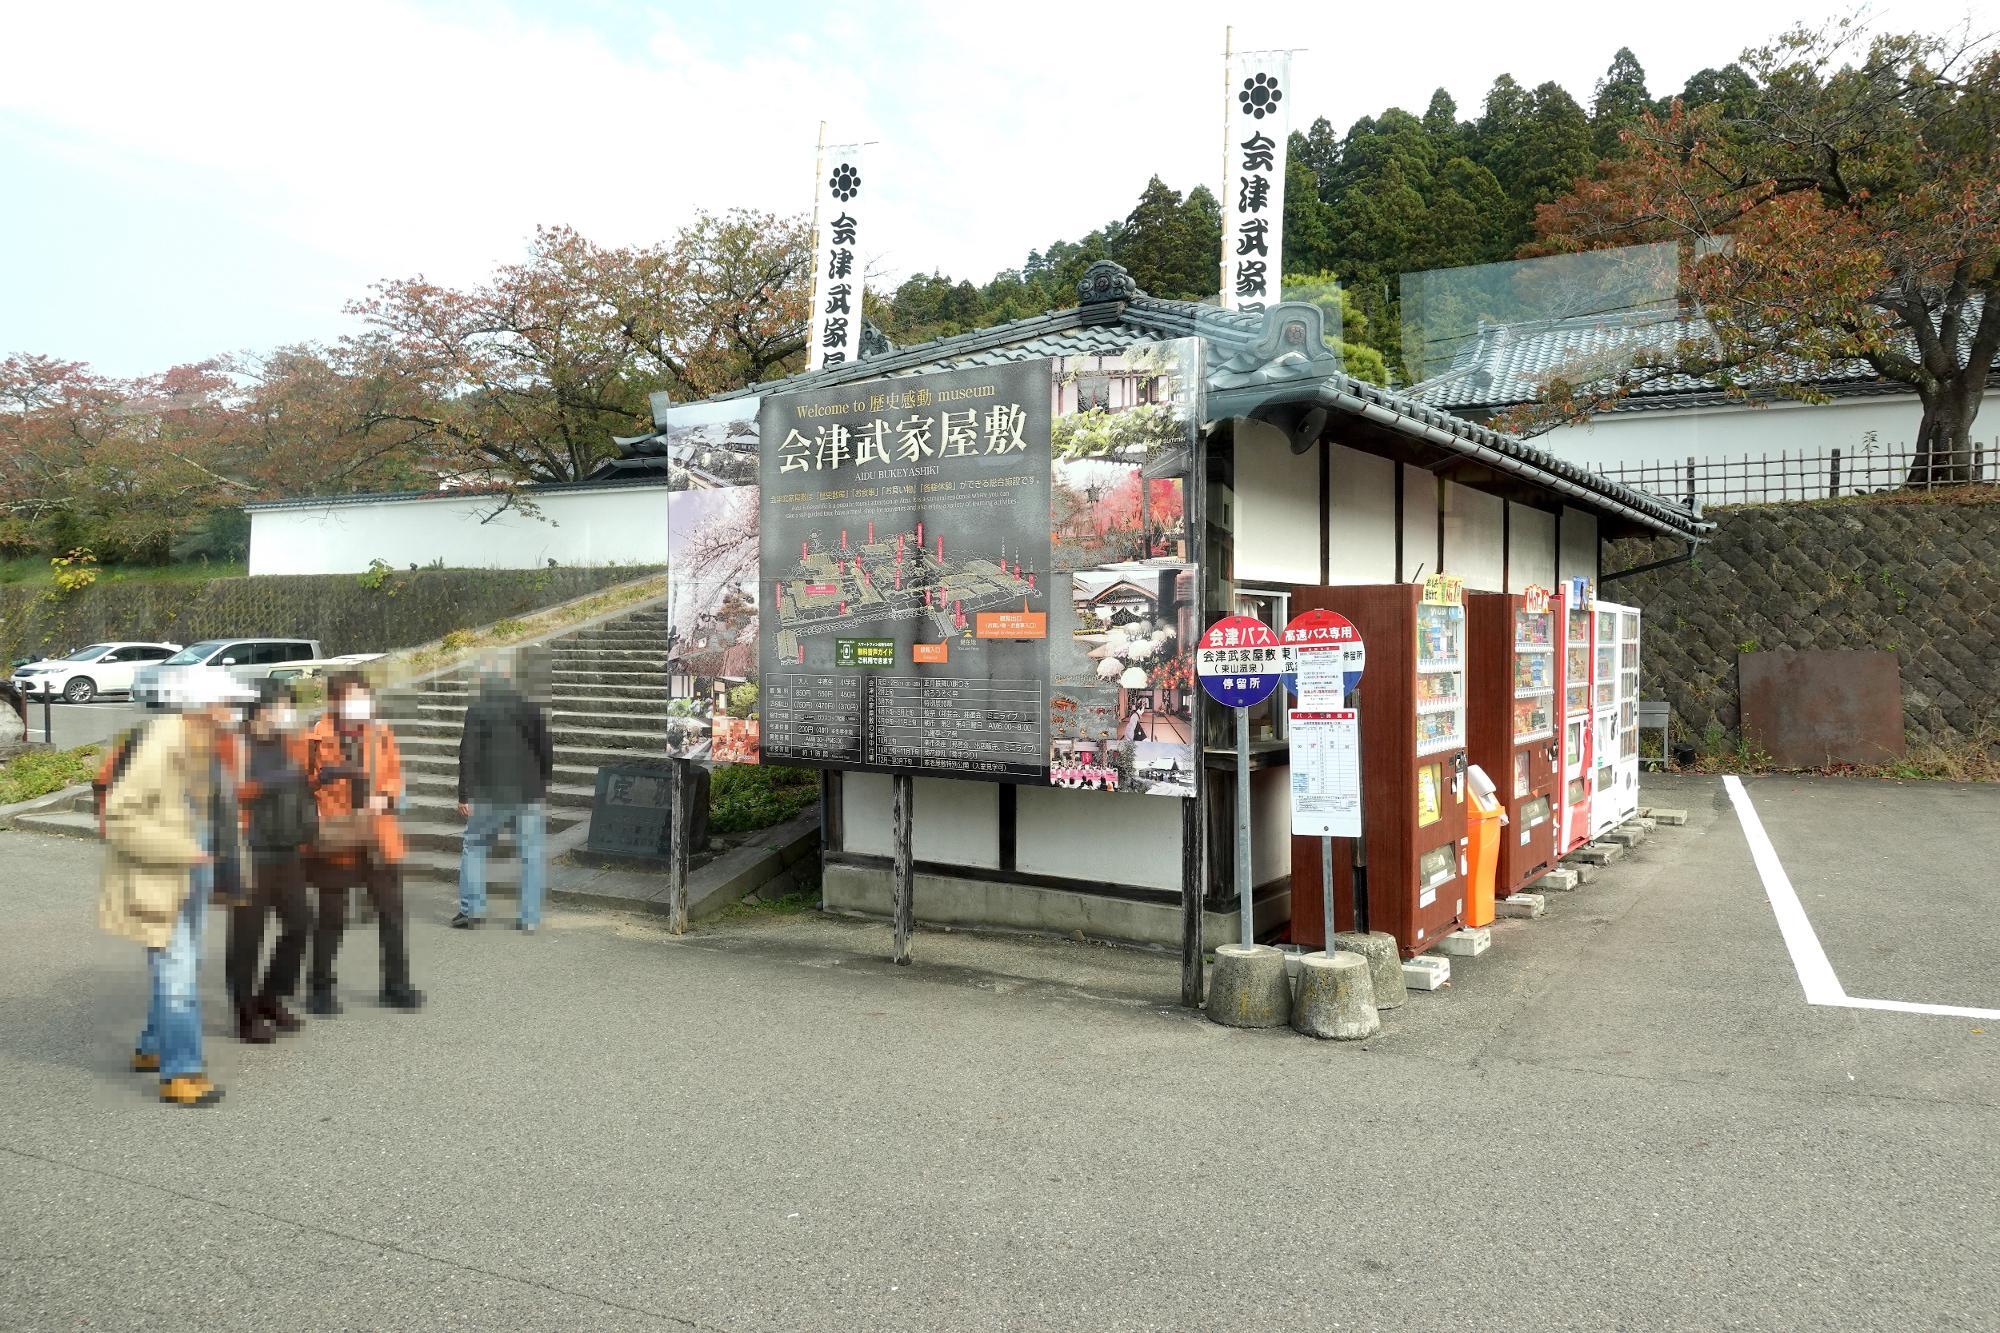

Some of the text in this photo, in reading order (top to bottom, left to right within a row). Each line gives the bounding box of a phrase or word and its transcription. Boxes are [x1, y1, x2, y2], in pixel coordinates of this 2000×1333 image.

[797, 385, 995, 419] Welcome to 歴史感動 museum
[778, 403, 1027, 473] 会津武家屋敷
[1209, 626, 1271, 647] 会津バス
[1285, 627, 1352, 642] 高速バス専用
[857, 657, 893, 665] ご利用できます
[1203, 648, 1276, 663] 会津武家屋敷
[1223, 678, 1260, 690] 停留所
